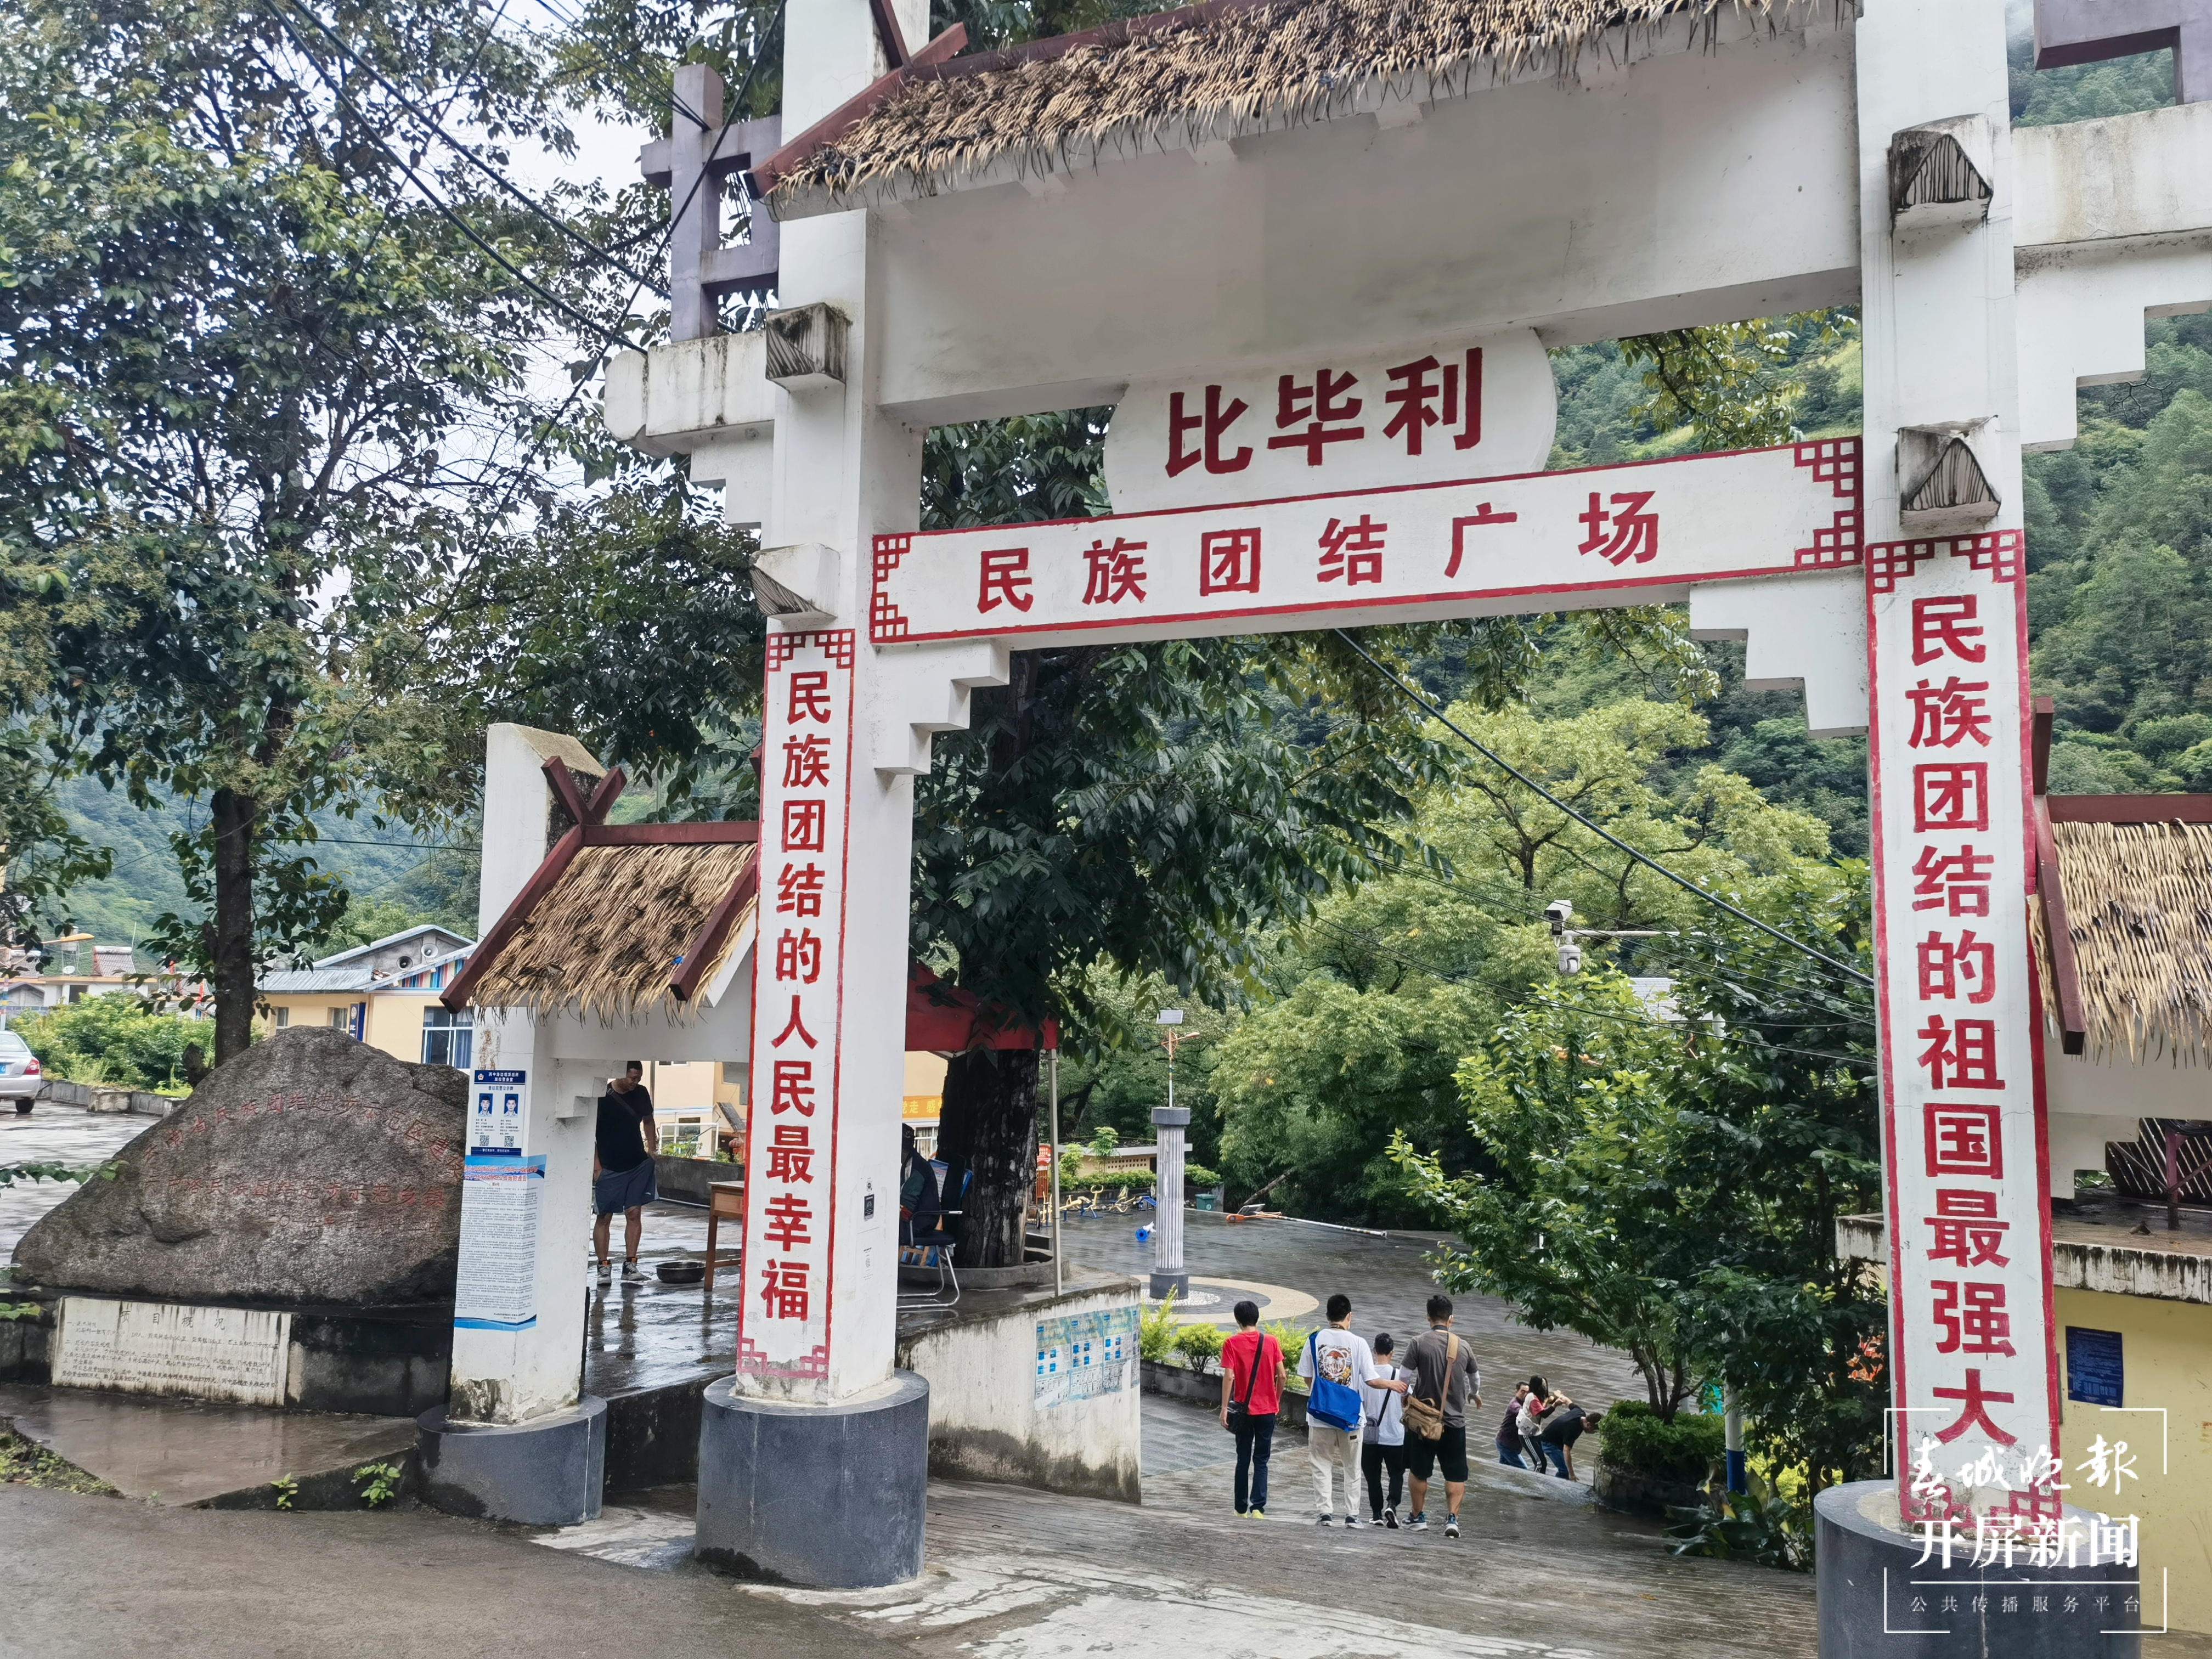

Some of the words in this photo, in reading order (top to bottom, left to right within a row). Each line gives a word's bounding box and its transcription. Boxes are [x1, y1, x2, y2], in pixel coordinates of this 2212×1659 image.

[978, 490, 1659, 614] 民族团结广场
[1165, 347, 1483, 477] 比毕利
[760, 670, 832, 1322] 民族团结的人民最幸福
[1905, 594, 2017, 1446] 民族团结的祖国最强大
